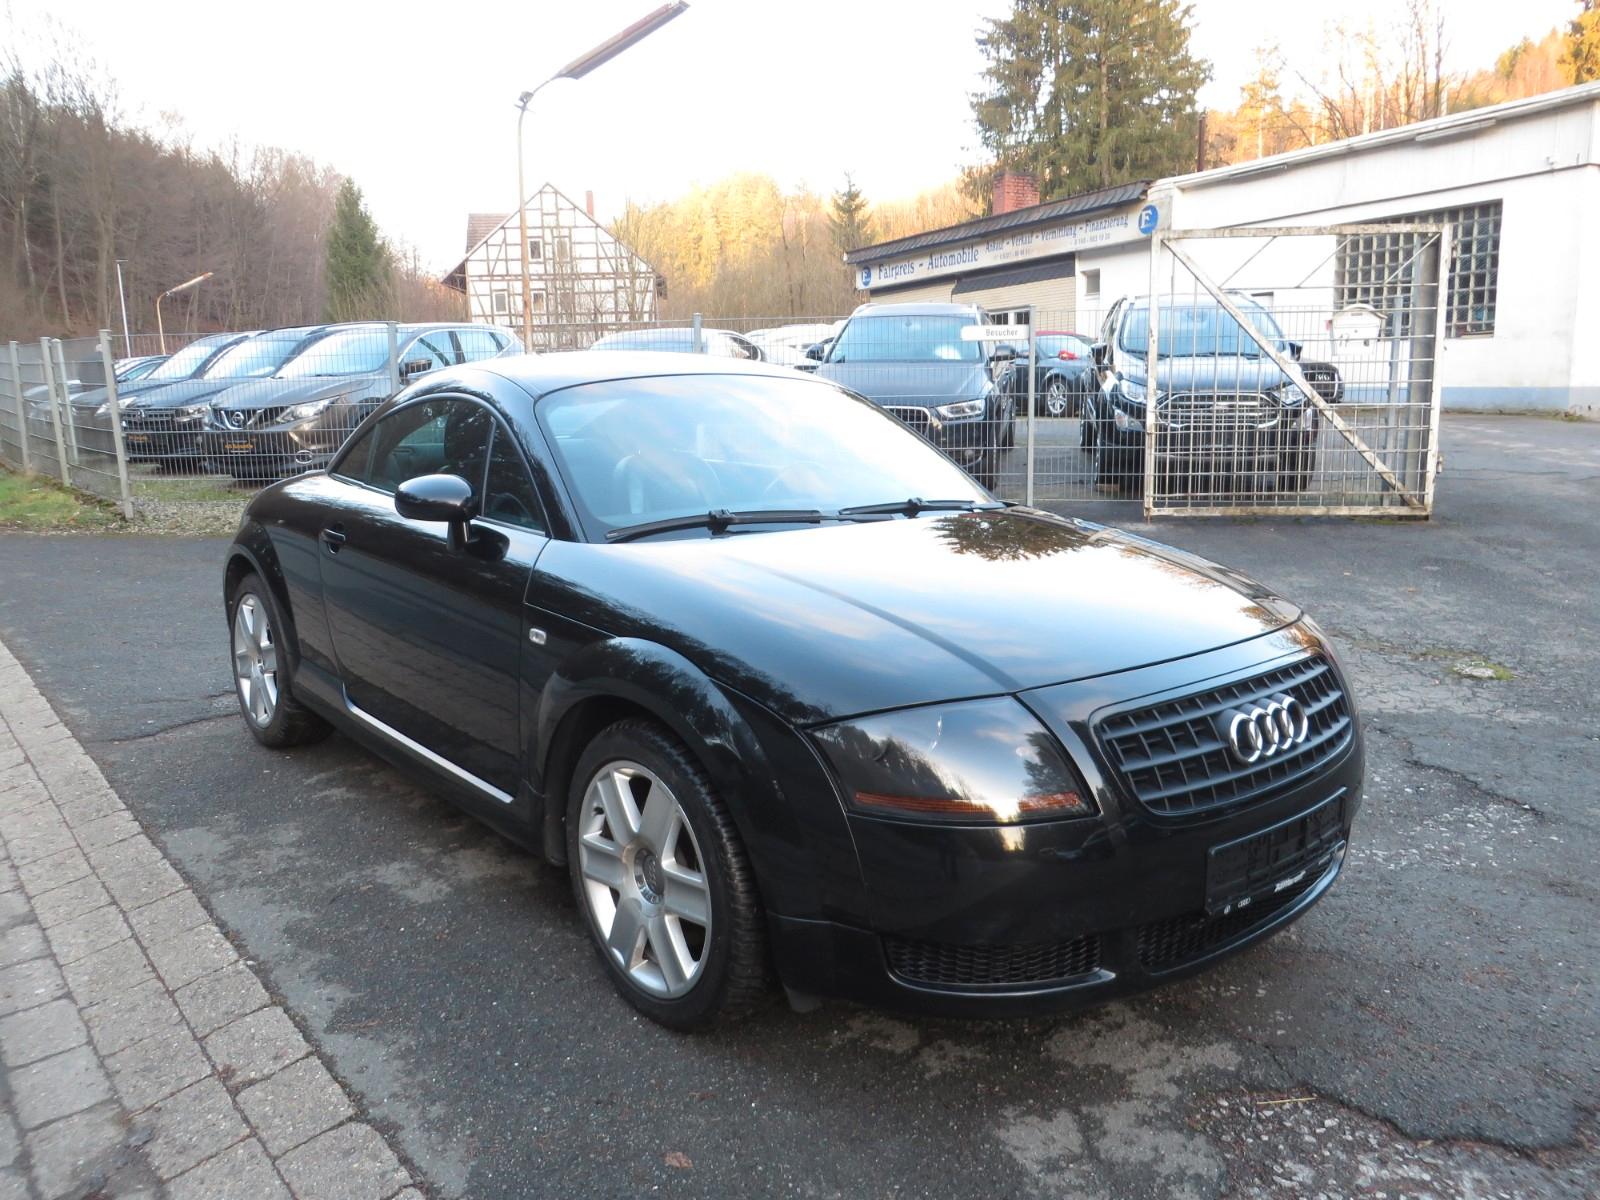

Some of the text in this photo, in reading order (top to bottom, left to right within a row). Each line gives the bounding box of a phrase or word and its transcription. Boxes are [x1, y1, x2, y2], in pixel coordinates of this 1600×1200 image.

[1085, 214, 1129, 233] Finanzierung
[878, 261, 915, 280] Fairpreis
[928, 246, 979, 270] Automobile
[985, 328, 1018, 337] Besucher
